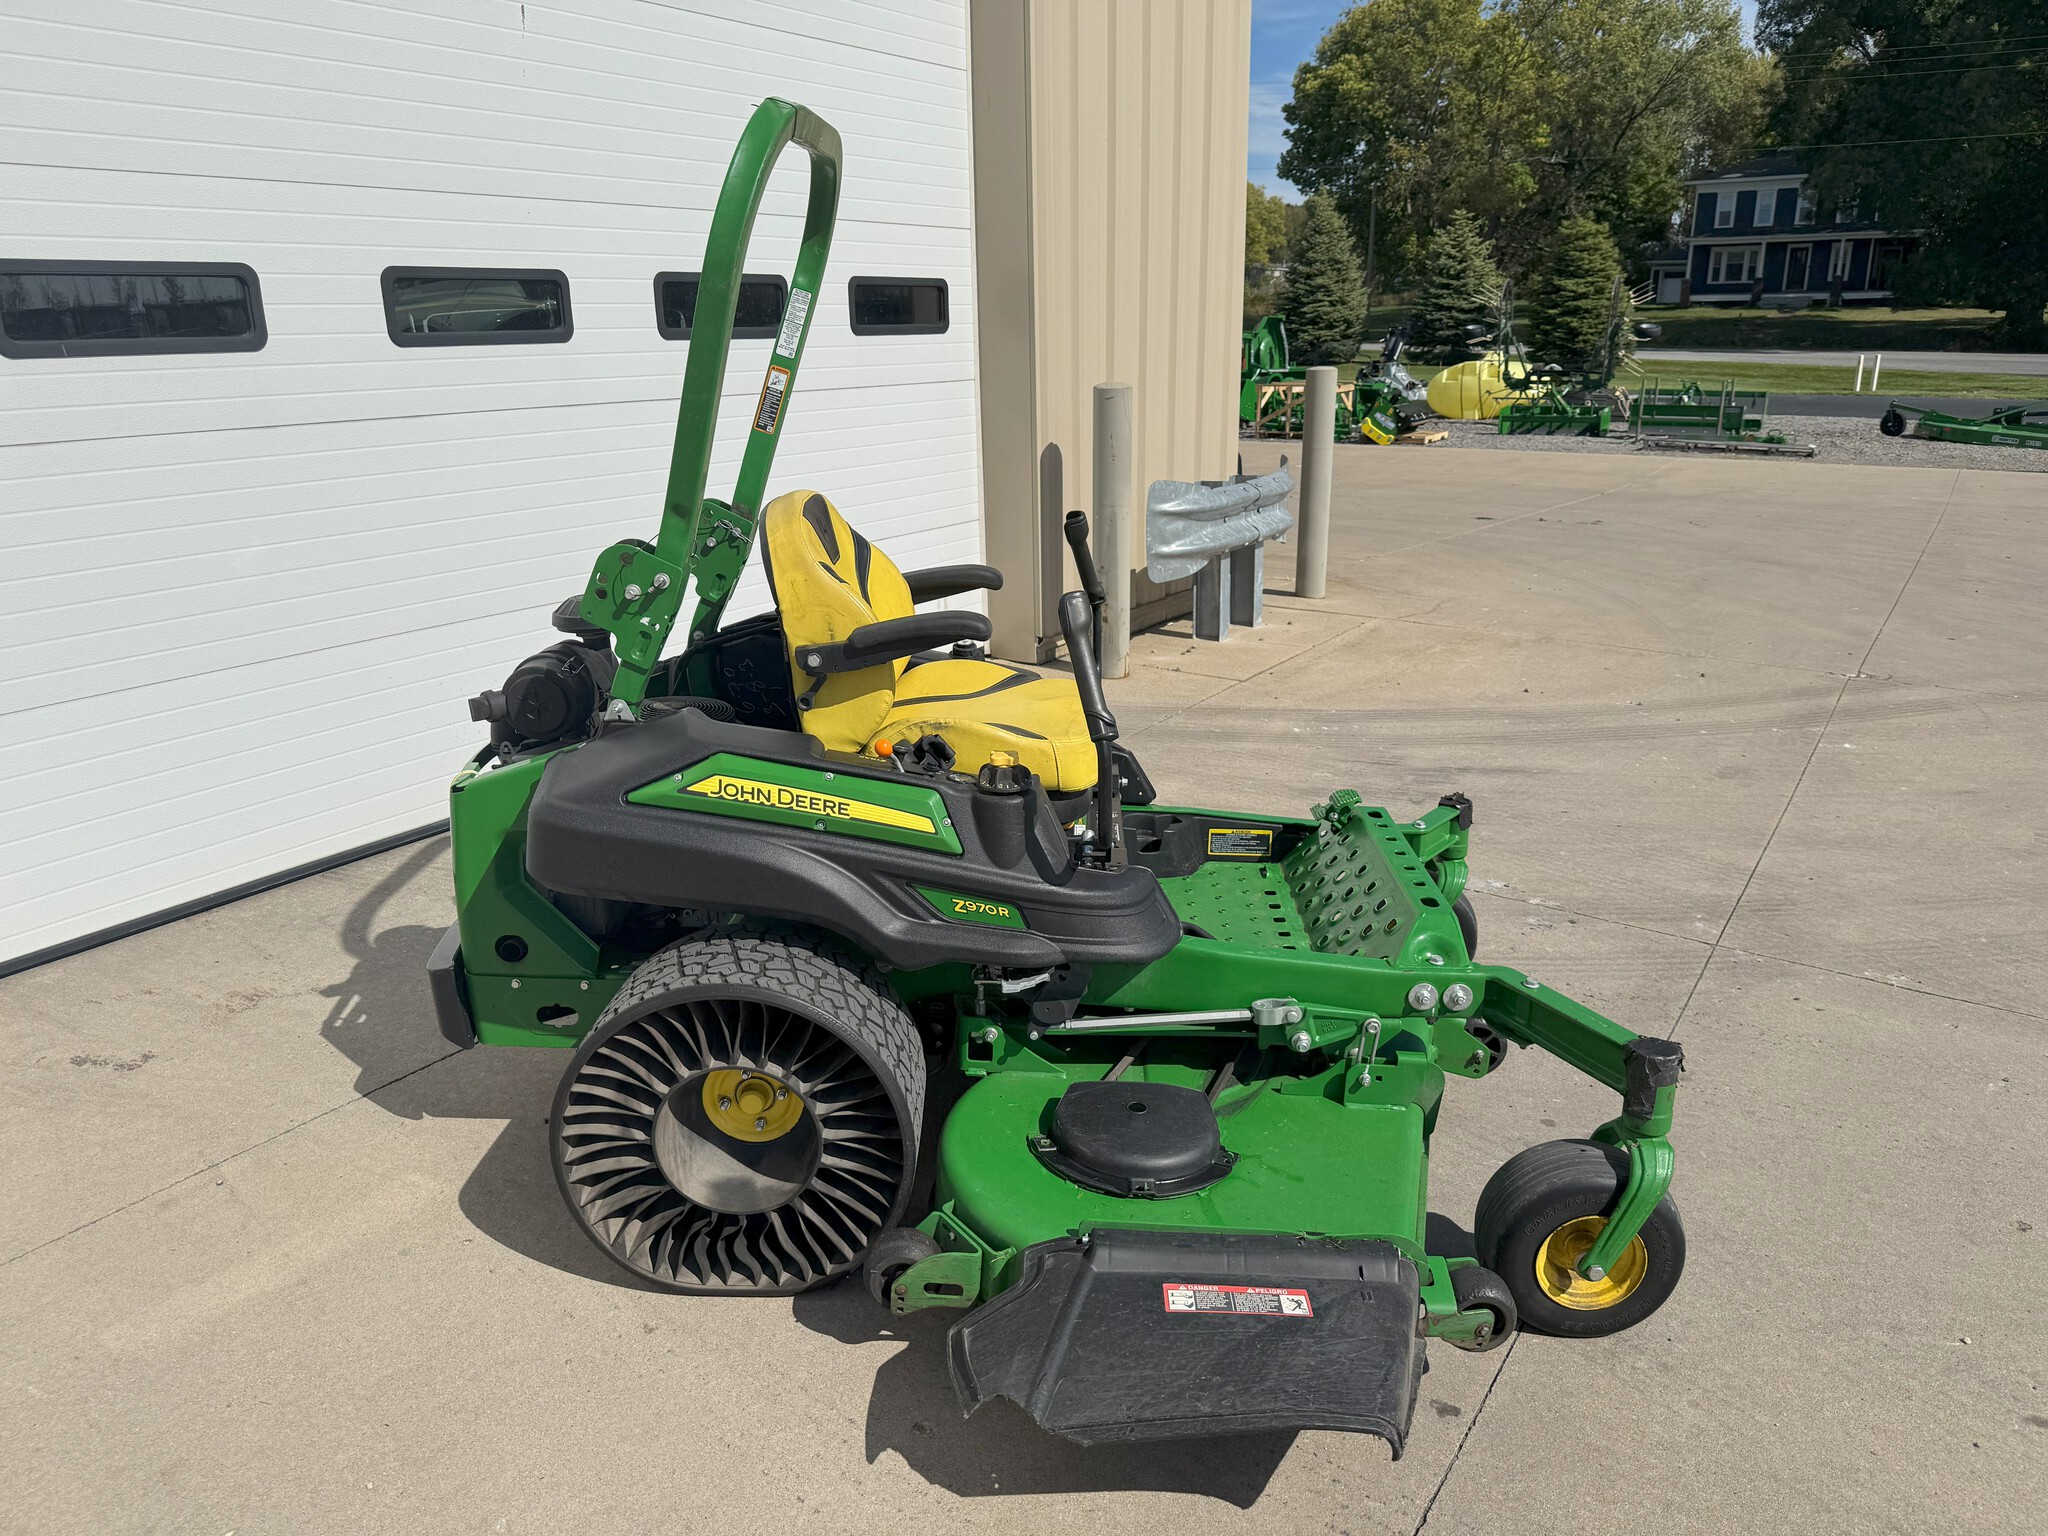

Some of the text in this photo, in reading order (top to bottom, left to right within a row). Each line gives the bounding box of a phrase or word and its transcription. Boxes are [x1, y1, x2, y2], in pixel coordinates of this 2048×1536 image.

[710, 778, 851, 817] JOHN DEERE
[952, 898, 1010, 918] Z970R
